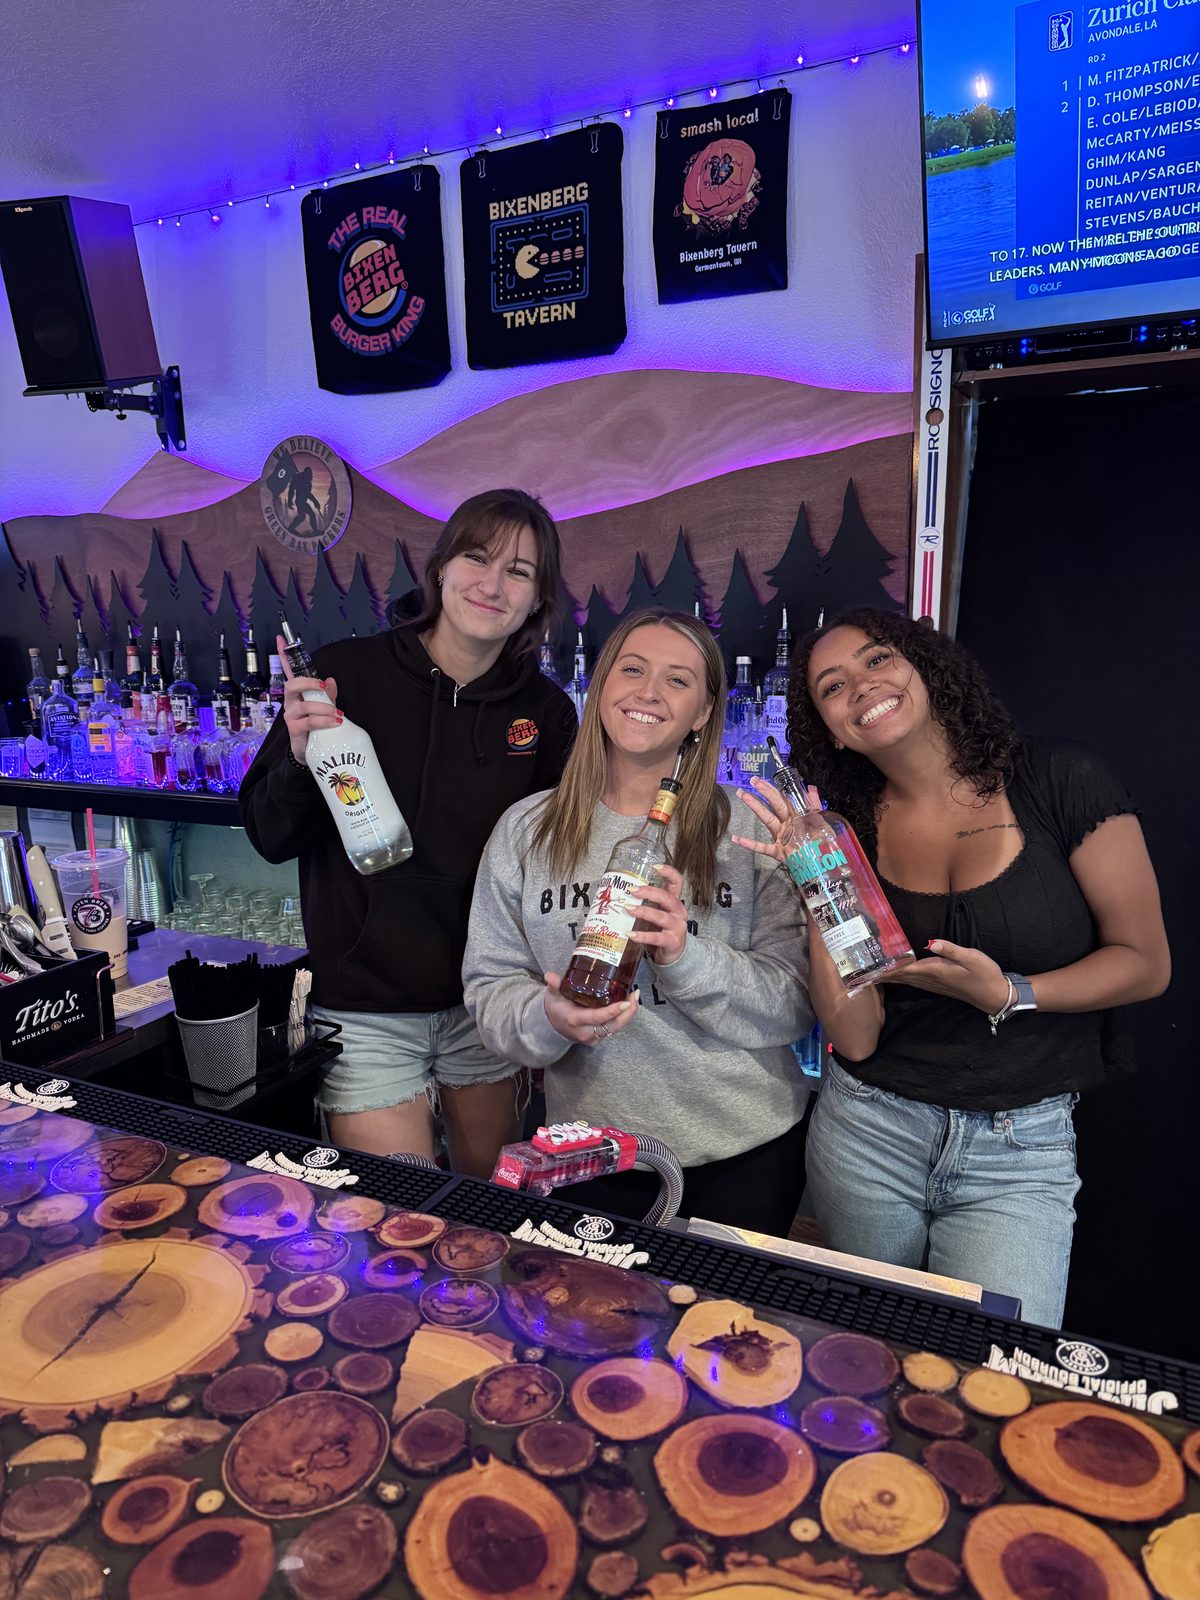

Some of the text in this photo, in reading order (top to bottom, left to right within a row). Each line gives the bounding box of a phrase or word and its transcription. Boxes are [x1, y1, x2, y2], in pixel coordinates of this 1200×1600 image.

[1144, 19, 1158, 30] LA
[1088, 53, 1106, 64] RD 2
[1062, 80, 1068, 92] 1
[1087, 73, 1102, 87] M.
[1061, 101, 1069, 113] 2
[1087, 96, 1100, 108] D.
[680, 108, 760, 139] smash local
[1087, 117, 1099, 129] E.
[1086, 145, 1166, 170] GHIM/KANG
[488, 182, 589, 221] BIXENBERG
[327, 206, 408, 251] THE REAL
[679, 240, 758, 264] Bixenberg Tavern
[990, 250, 1008, 262] TO
[1011, 247, 1029, 260] 17.
[1032, 241, 1065, 257] NOW
[343, 244, 397, 292] BIXEN
[989, 265, 1046, 282] LEADERS.
[345, 260, 405, 318] BERG
[1040, 281, 1062, 292] GOLF
[330, 295, 425, 353] BURGER KING
[503, 301, 576, 329] TAVERN
[963, 308, 990, 320] GOLF
[928, 349, 944, 451] ROSIGNO
[311, 510, 346, 552] PCKERS
[508, 728, 539, 745] BERG
[316, 752, 366, 781] MALIBU
[740, 762, 759, 771] LIME
[91, 899, 109, 910] BREW
[11, 1012, 86, 1046] HANDMADE VODKA
